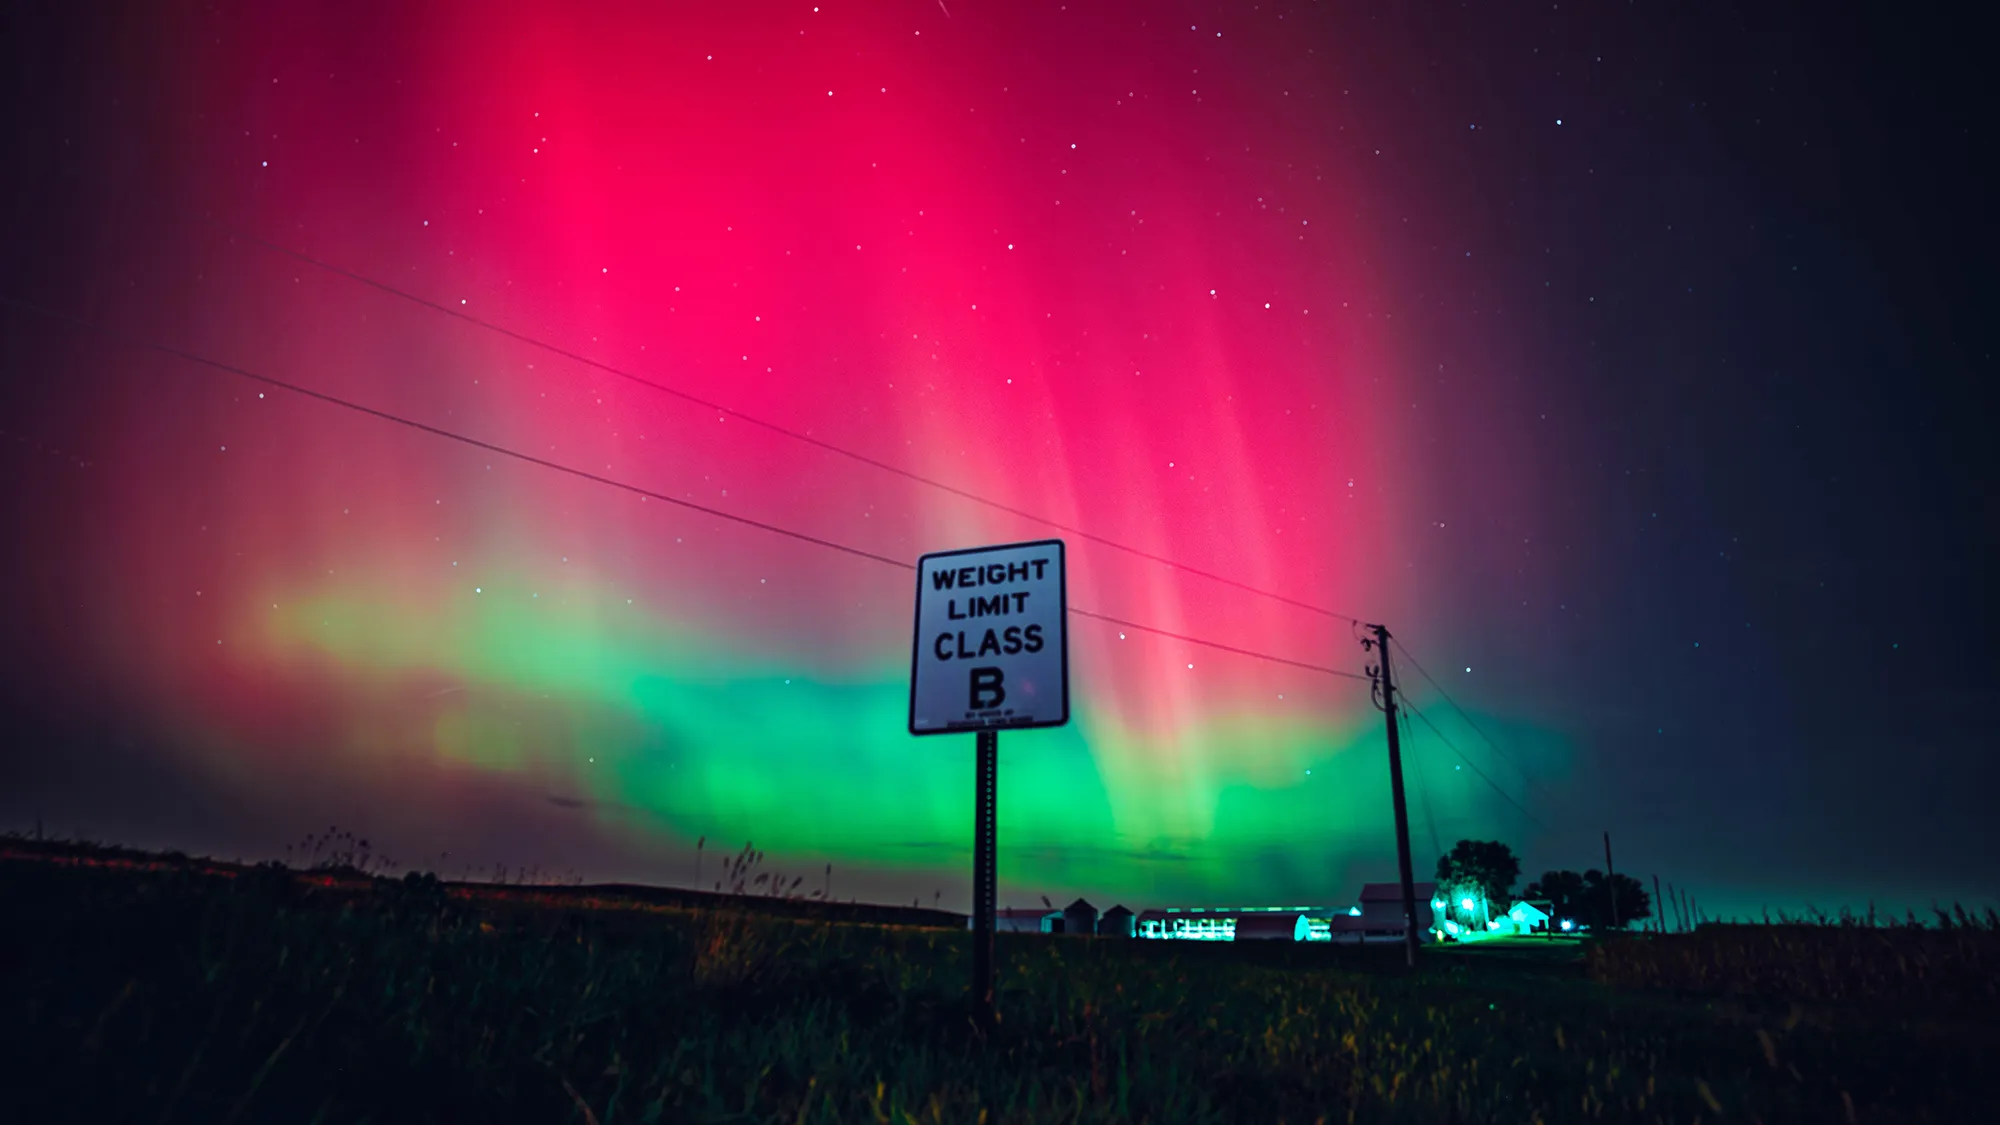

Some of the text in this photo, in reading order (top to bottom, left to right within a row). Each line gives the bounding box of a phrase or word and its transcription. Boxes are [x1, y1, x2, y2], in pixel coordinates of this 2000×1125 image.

[932, 558, 1049, 591] WEIGHT
[948, 591, 1030, 620] LIMIT
[934, 624, 1044, 661] CLASS
[969, 666, 1006, 710] B
